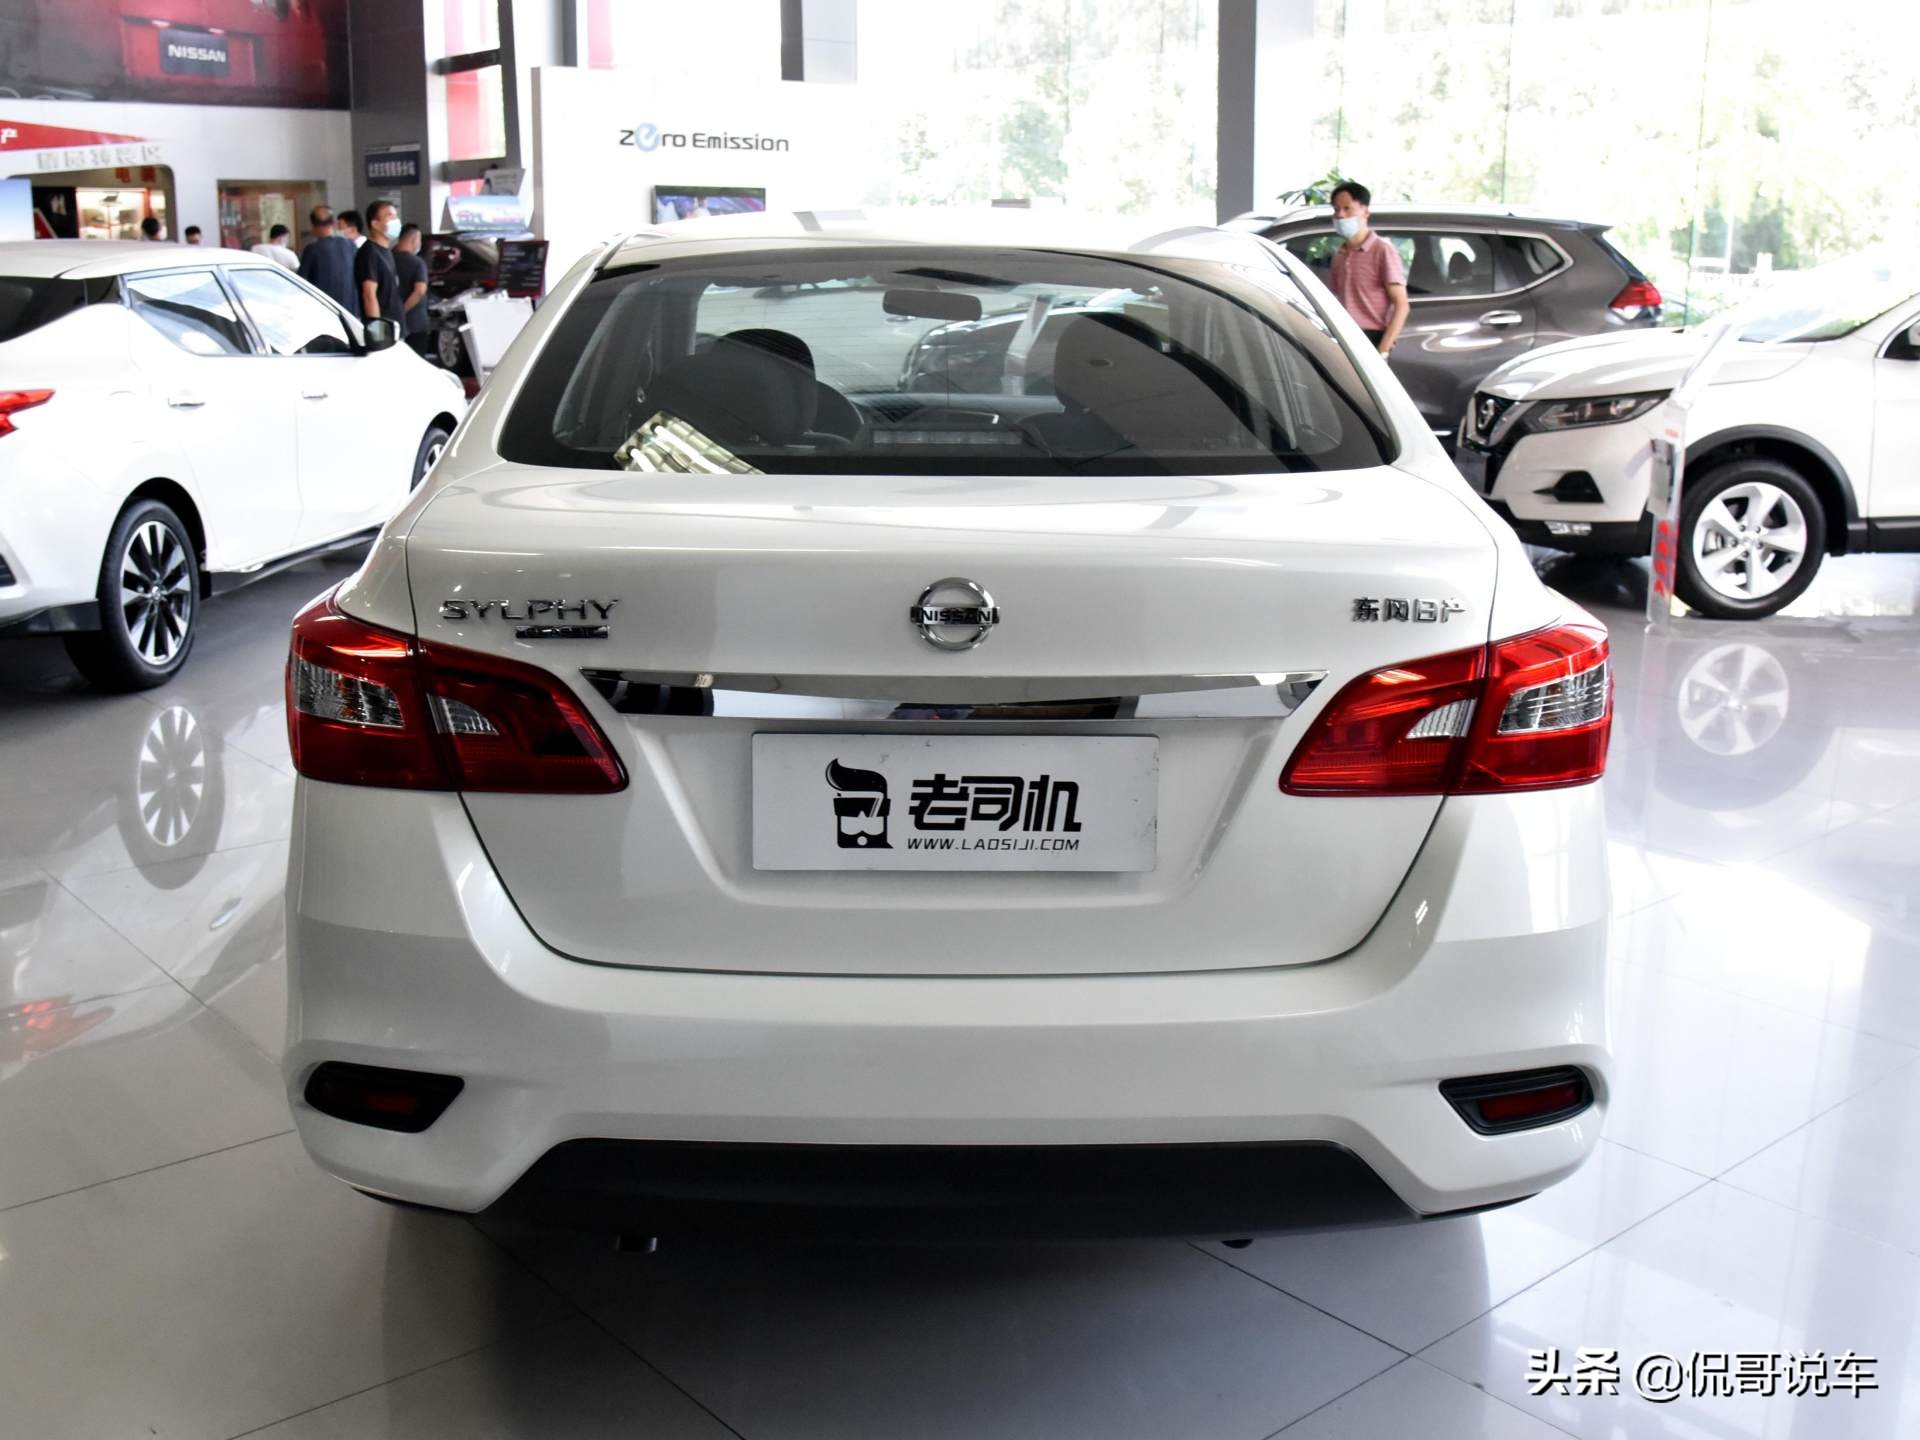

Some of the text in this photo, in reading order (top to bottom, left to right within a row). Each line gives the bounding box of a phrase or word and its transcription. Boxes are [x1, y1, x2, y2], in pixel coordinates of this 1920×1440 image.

[167, 44, 226, 63] NISSAN
[692, 132, 789, 152] Emission
[439, 598, 619, 621] SYLPHY
[921, 608, 992, 623] NISSAN
[1351, 597, 1466, 623] 东风日产
[908, 773, 1082, 832] 老司机
[907, 838, 1080, 851] WWW.LAOSIJI.COM
